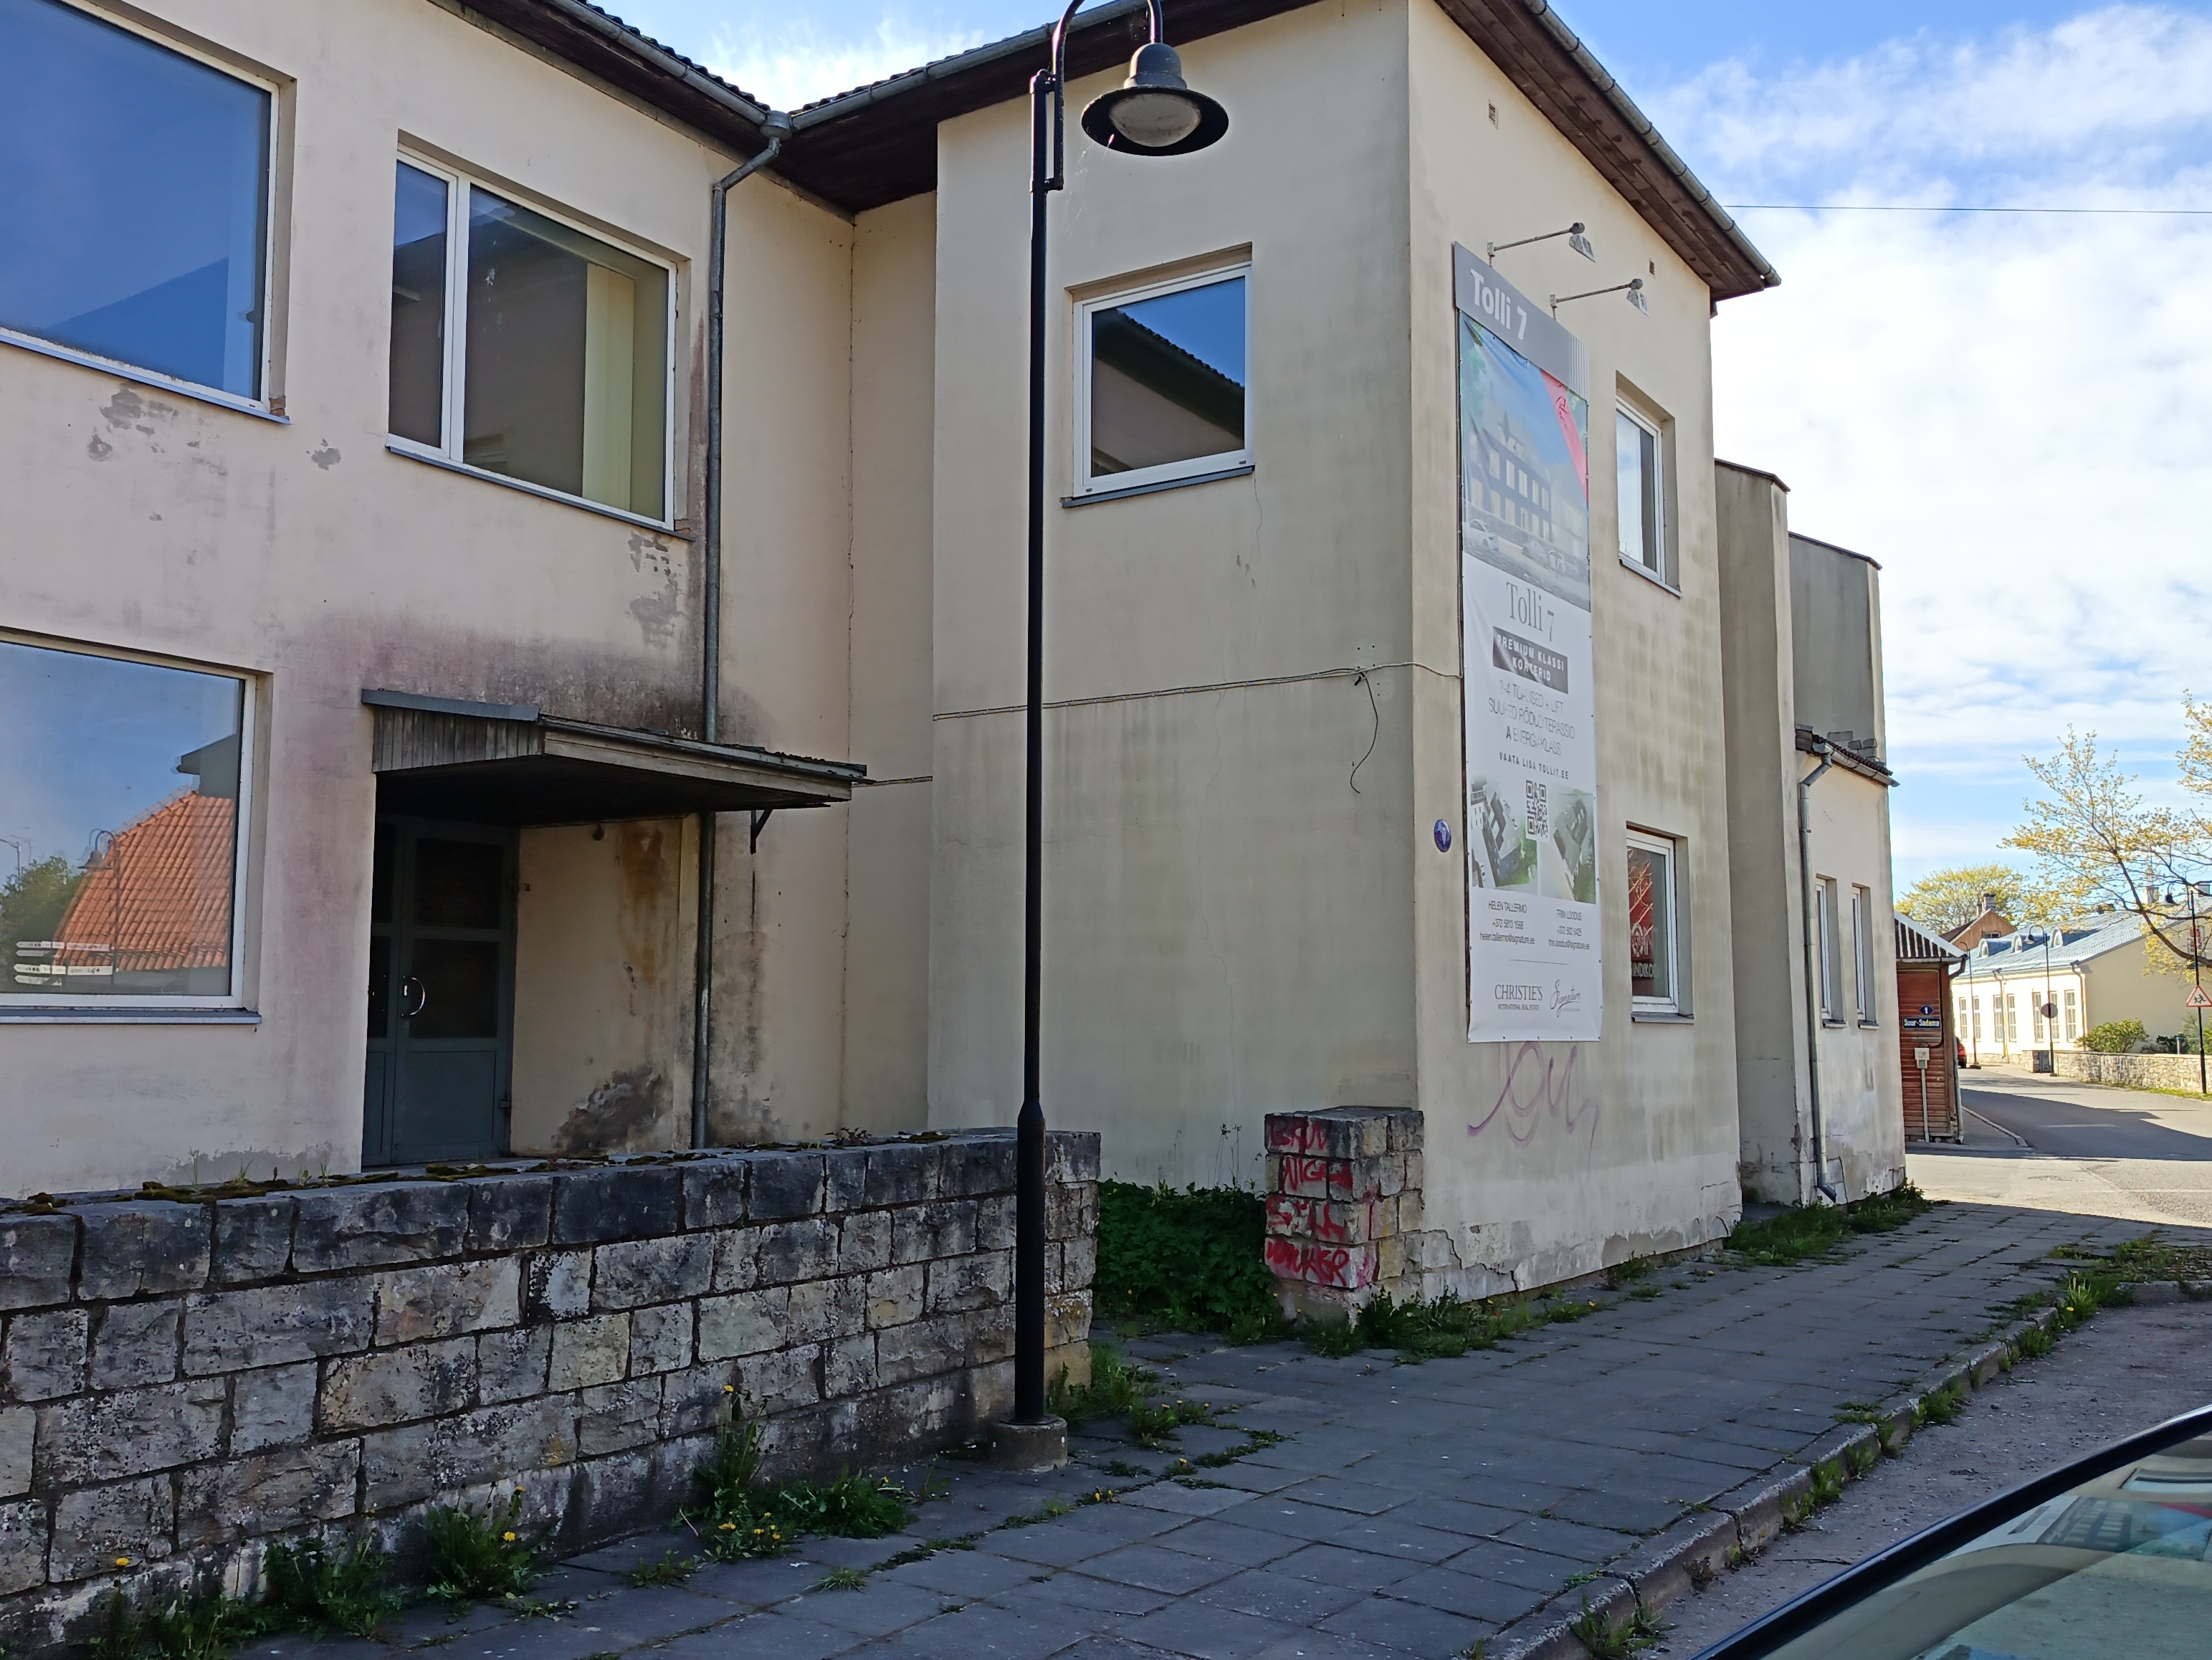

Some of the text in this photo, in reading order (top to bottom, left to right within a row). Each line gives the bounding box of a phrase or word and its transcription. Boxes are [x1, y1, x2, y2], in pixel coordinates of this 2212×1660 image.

[1470, 268, 1527, 341] Tolli 7
[1506, 581, 1555, 642] Tolli 7
[1497, 634, 1564, 672] PREMIUM KLASSI
[1512, 657, 1551, 682] KORTERID
[1551, 699, 1565, 715] LIFT
[1505, 725, 1512, 740] A
[1499, 751, 1569, 780] VAATA LISA TOLLIT.EE
[1494, 984, 1543, 1001] CHRISTIE'S
